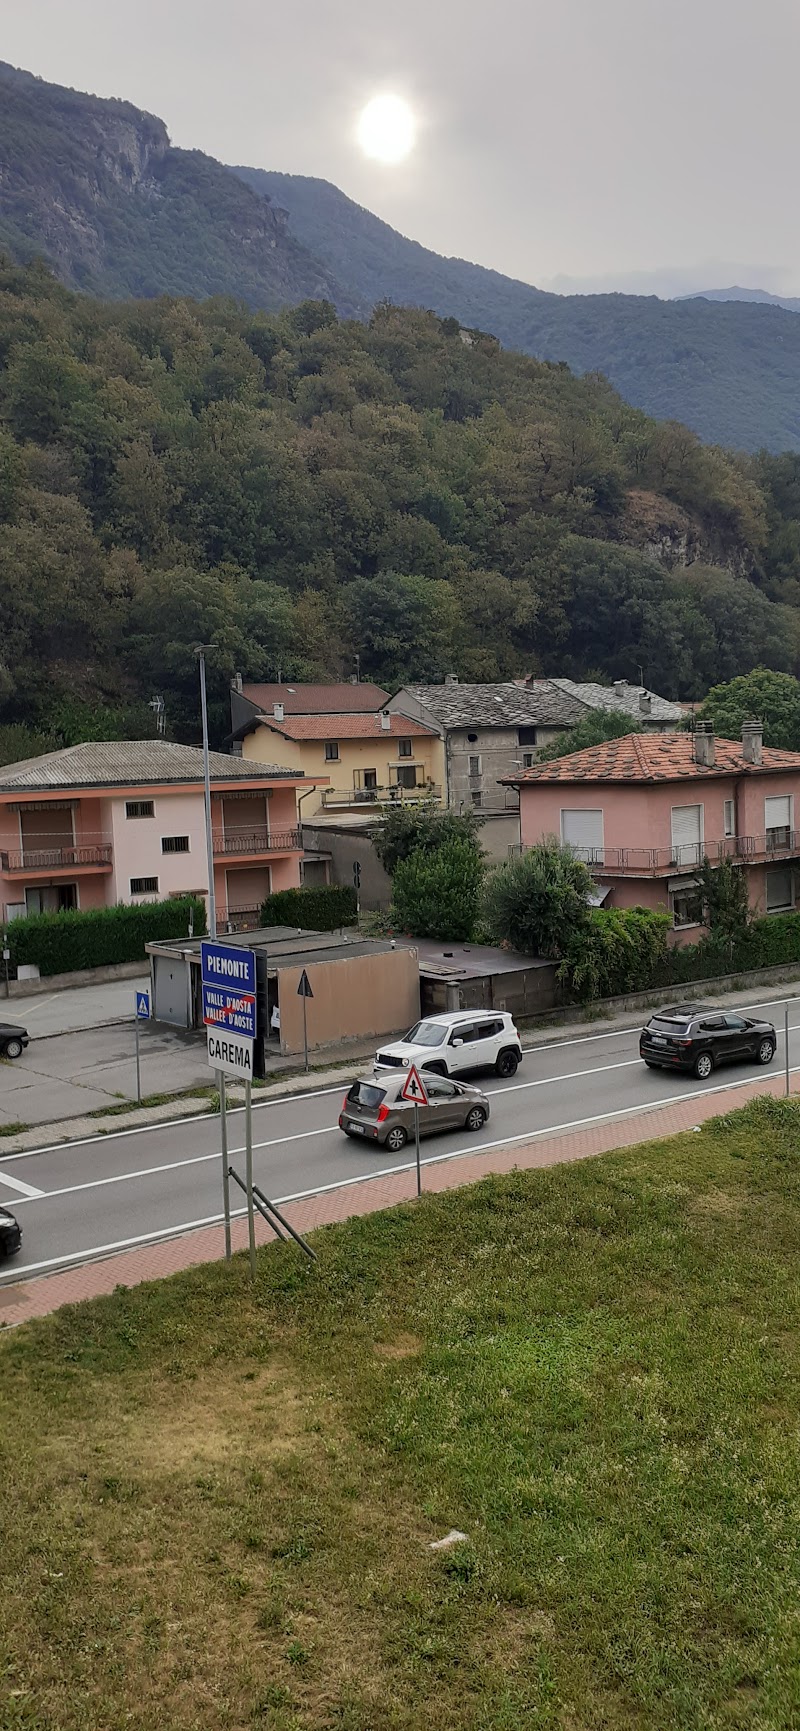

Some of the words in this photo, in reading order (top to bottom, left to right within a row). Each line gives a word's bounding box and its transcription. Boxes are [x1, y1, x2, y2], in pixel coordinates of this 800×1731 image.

[207, 955, 249, 980] PIEMONTE
[206, 991, 224, 1007] VALLE
[226, 996, 252, 1014] D'AOSTA
[205, 1006, 226, 1023] VALLEE
[228, 1012, 253, 1031] D'AOSTE
[208, 1037, 251, 1070] CAREMA
